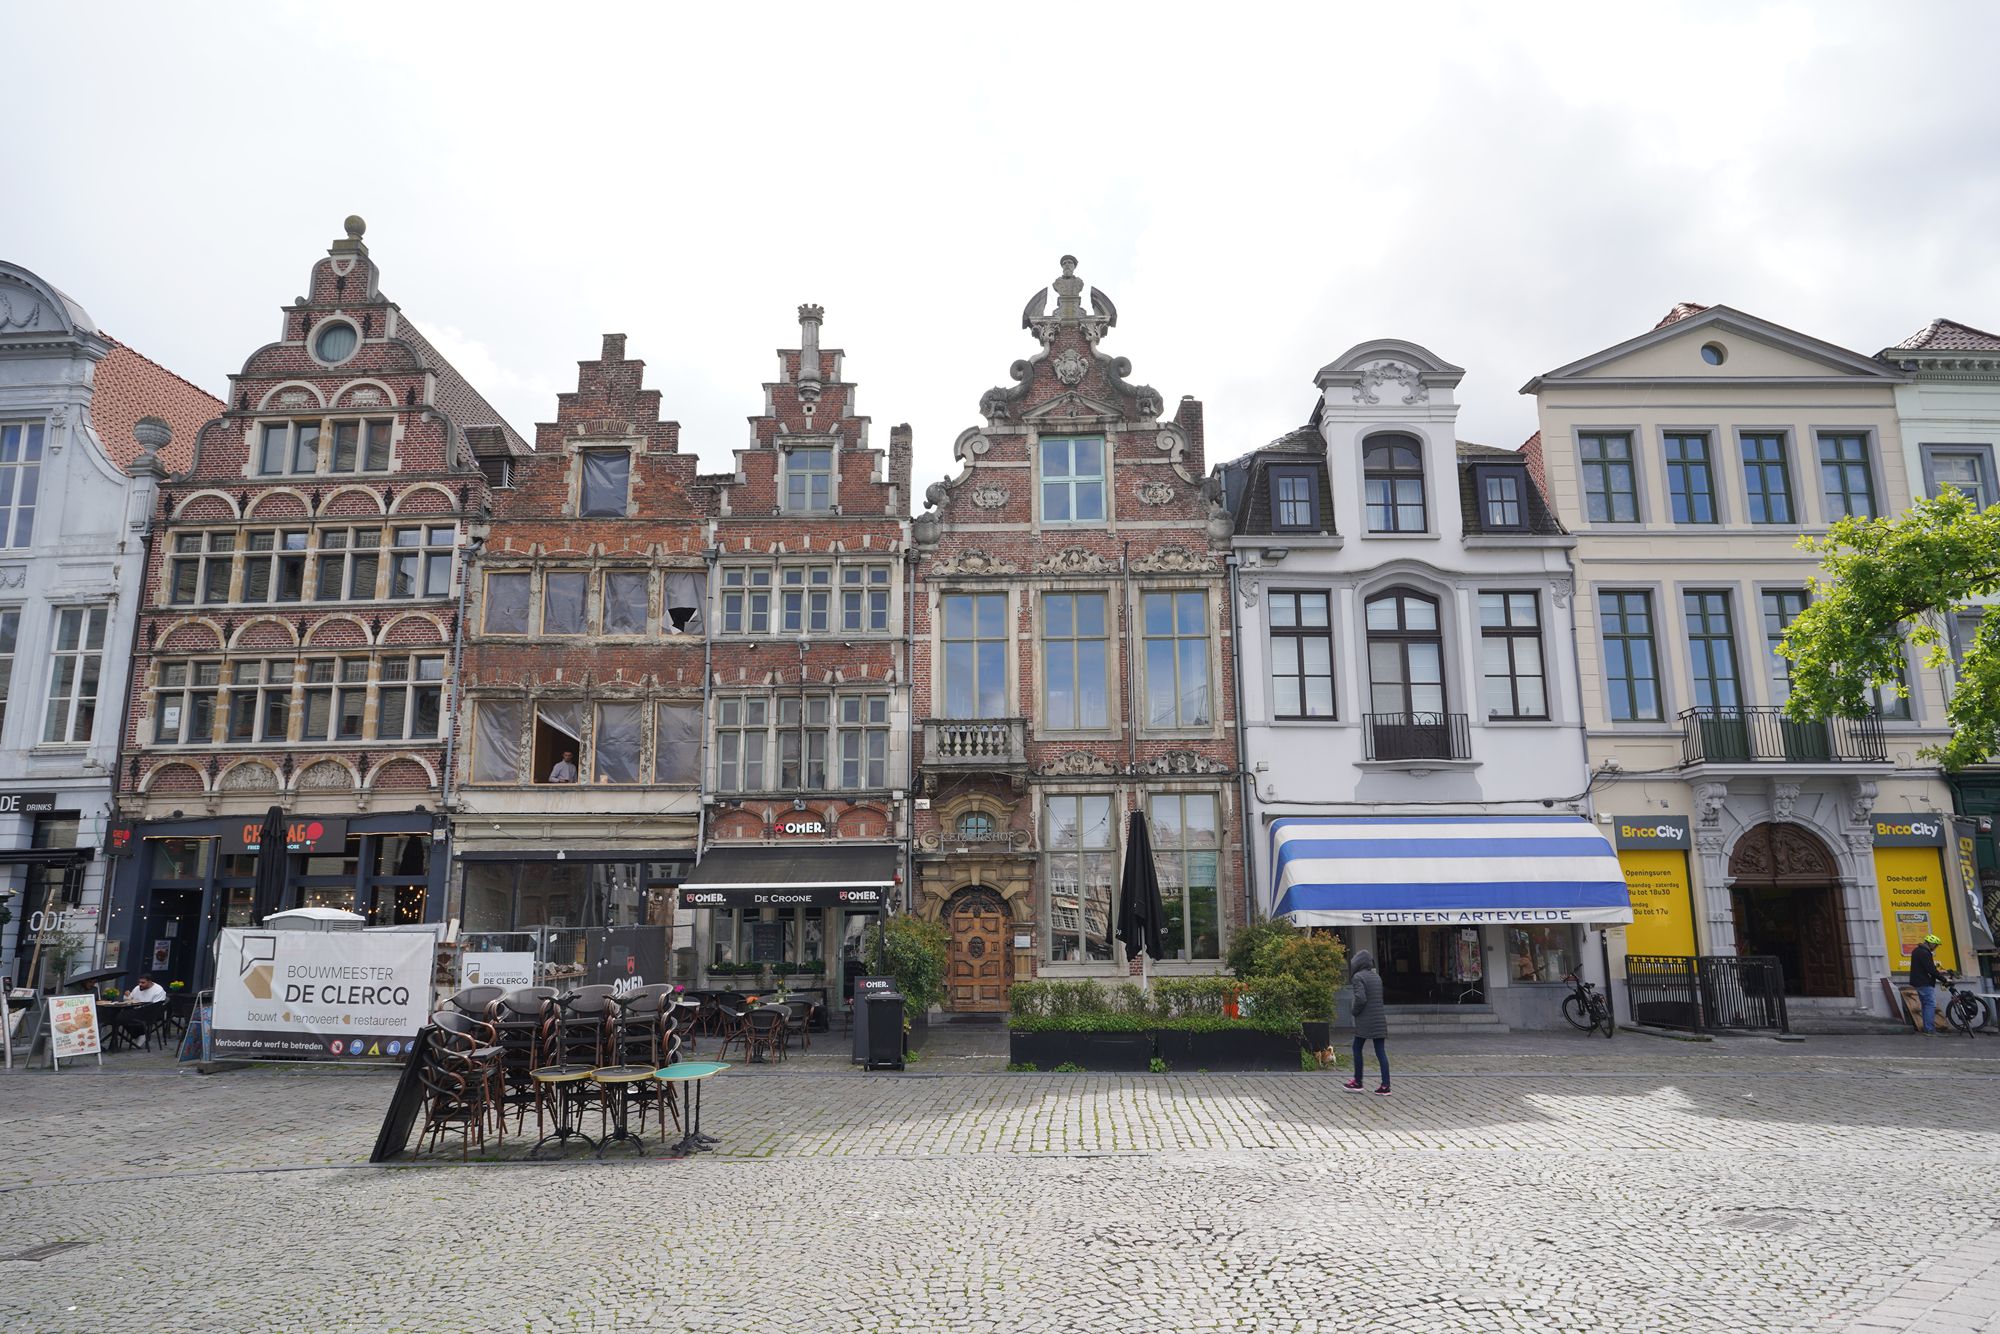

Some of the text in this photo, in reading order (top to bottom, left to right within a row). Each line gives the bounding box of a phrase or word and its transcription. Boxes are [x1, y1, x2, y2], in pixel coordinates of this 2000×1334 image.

[0, 795, 52, 812] DE DRINKS
[785, 822, 825, 834] OMER.
[1621, 825, 1684, 841] BricoCity
[1877, 822, 1938, 838] BricoCity
[1625, 869, 1671, 878] Openingsuren
[695, 893, 727, 902] OMER.
[754, 894, 812, 903] DE CROONE
[848, 891, 880, 900] OMER.
[1362, 910, 1571, 923] STOFFEN ARTEVELDE
[287, 965, 394, 980] BOUWMEESTER
[496, 977, 528, 985] CLERCQ
[285, 984, 409, 1005] DE CLERCQ
[248, 1010, 407, 1027] bouwt renoveert restaureert
[215, 1038, 250, 1047] Verboden
[252, 1040, 262, 1048] de
[281, 1041, 289, 1049] te
[290, 1041, 323, 1050] betreden
